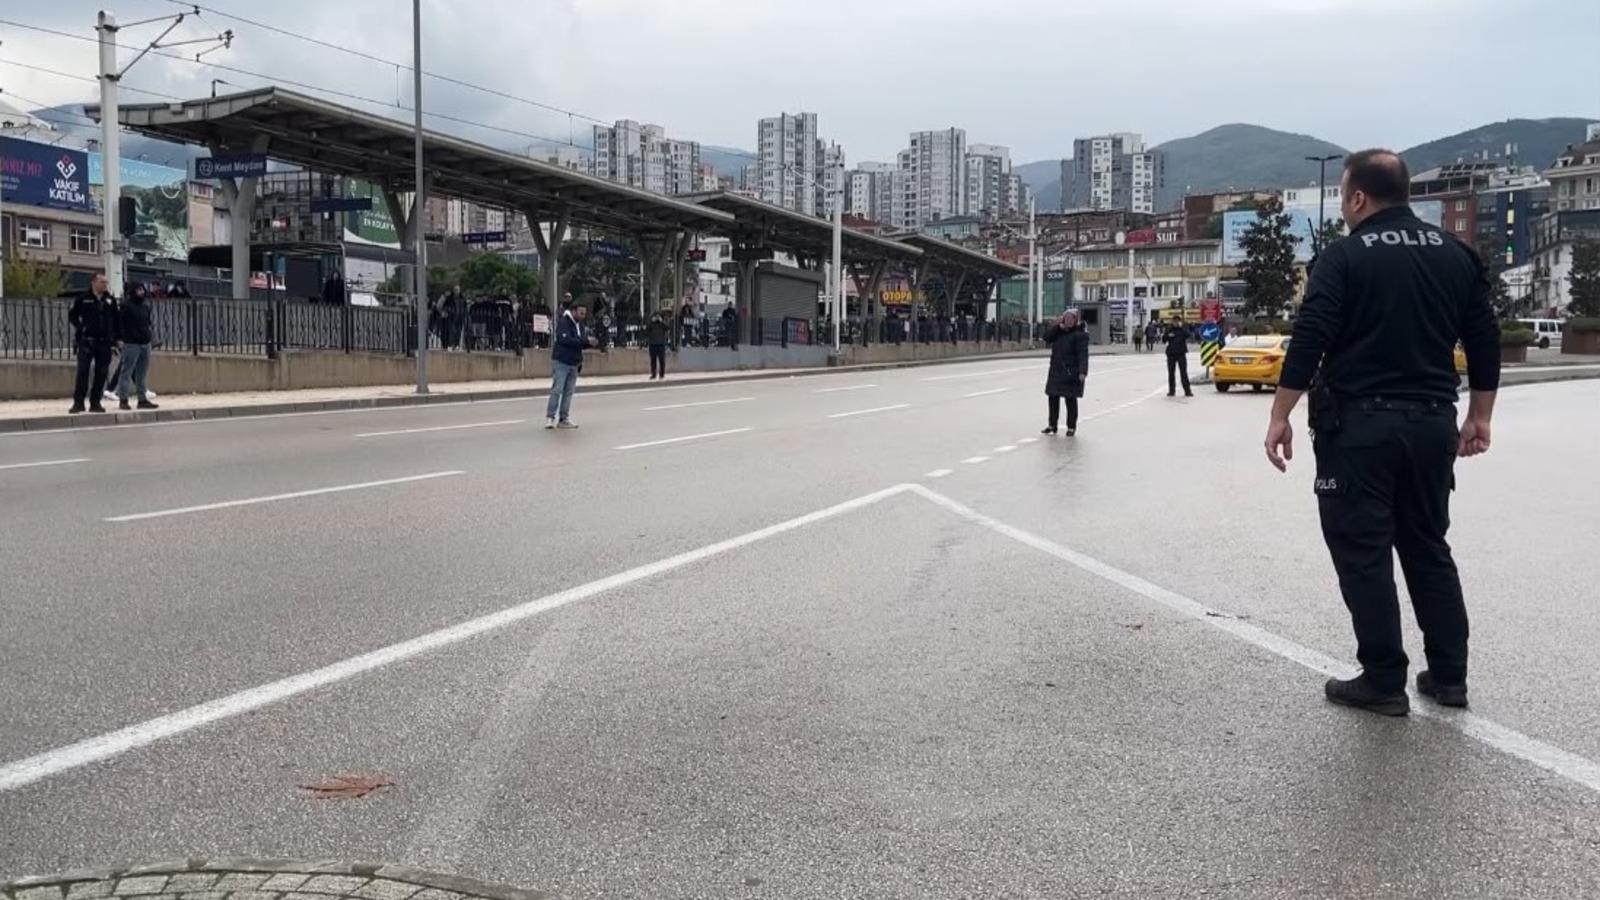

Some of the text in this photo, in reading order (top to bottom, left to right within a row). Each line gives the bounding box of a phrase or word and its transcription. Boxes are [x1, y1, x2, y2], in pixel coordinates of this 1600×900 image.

[214, 162, 232, 173] Kent
[54, 178, 80, 192] VAKIF
[49, 188, 86, 204] KATILIM
[1156, 232, 1178, 242] SUIT
